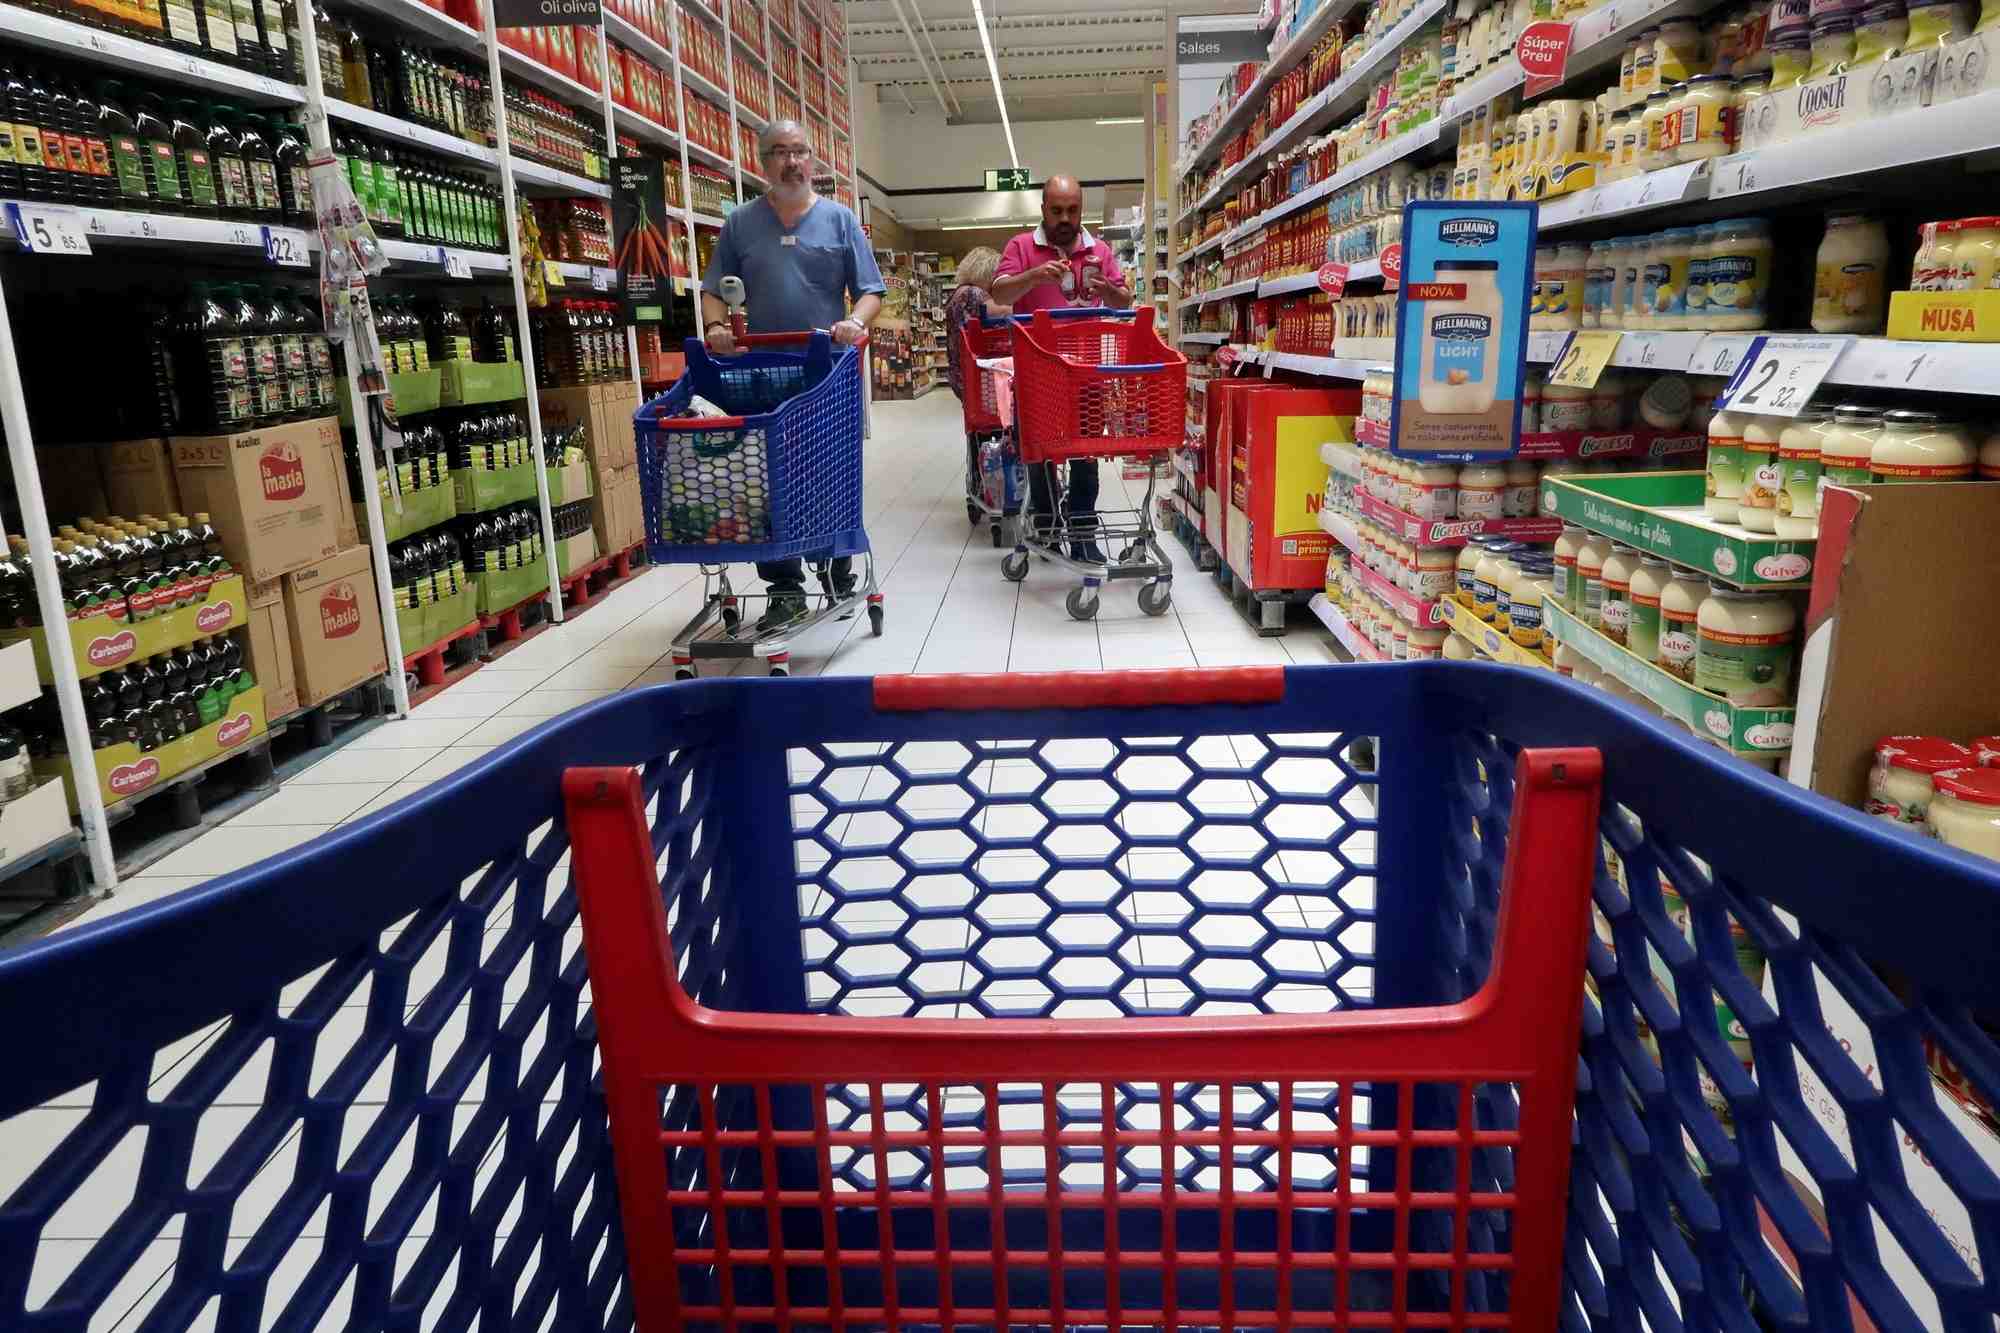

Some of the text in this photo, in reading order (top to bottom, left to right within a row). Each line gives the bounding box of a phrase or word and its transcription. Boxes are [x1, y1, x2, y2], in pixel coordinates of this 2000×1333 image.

[541, 0, 596, 14] Oli oliva
[1179, 41, 1220, 55] Salses
[1523, 36, 1565, 51] Súper
[1520, 49, 1553, 62] Preu
[33, 217, 51, 248] 5
[1442, 222, 1496, 236] HELLMANN'S
[272, 237, 293, 262] 22
[1420, 286, 1455, 297] NOVA
[1435, 318, 1488, 331] HELLMANN'S
[1921, 308, 1976, 332] MUSA
[1440, 346, 1479, 357] LIGHT
[1740, 358, 1780, 405] 2
[1432, 521, 1485, 541] LIGERESA
[90, 638, 134, 660] Carbonell
[111, 764, 157, 788] Carbonell
